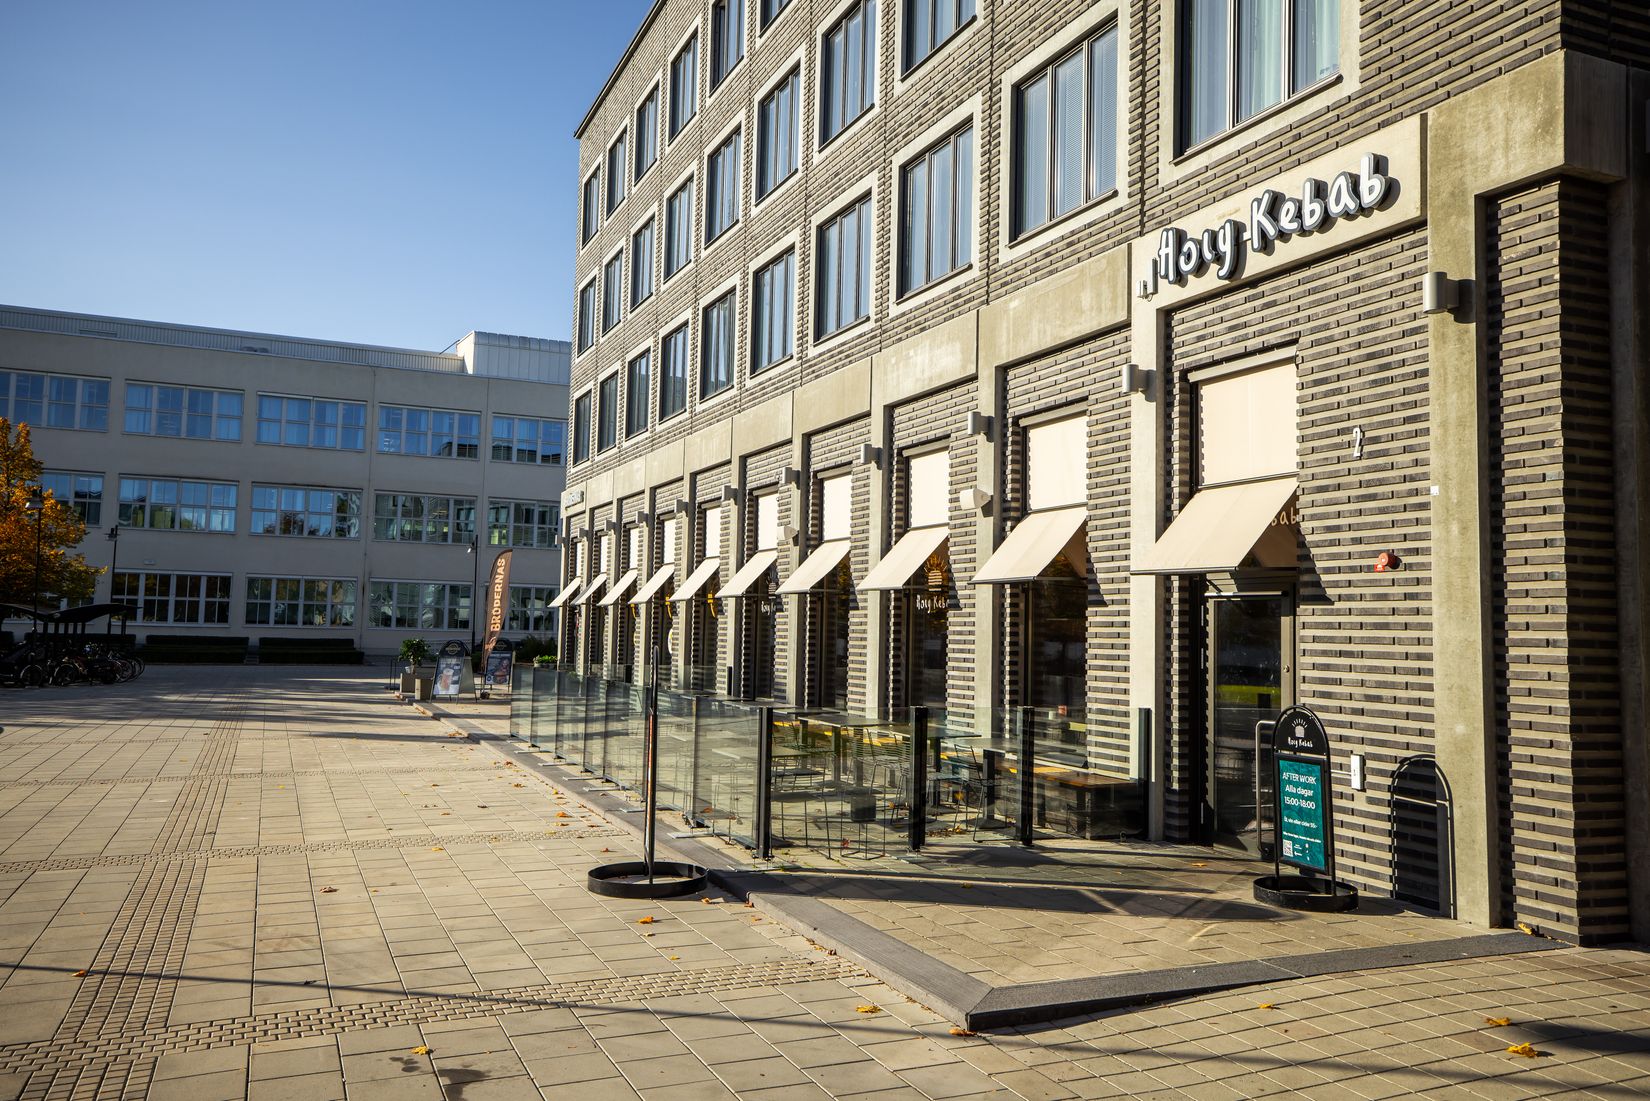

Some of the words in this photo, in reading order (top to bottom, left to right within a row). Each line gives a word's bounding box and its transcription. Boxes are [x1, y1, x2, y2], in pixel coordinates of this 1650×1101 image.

[1251, 152, 1389, 251] Kebab
[1353, 427, 1361, 457] 2
[490, 558, 506, 632] BRÖDERNAS
[1282, 772, 1299, 782] AFTER
[1300, 775, 1317, 785] WORK
[1285, 784, 1296, 793] Alla
[1297, 787, 1313, 797] dagar
